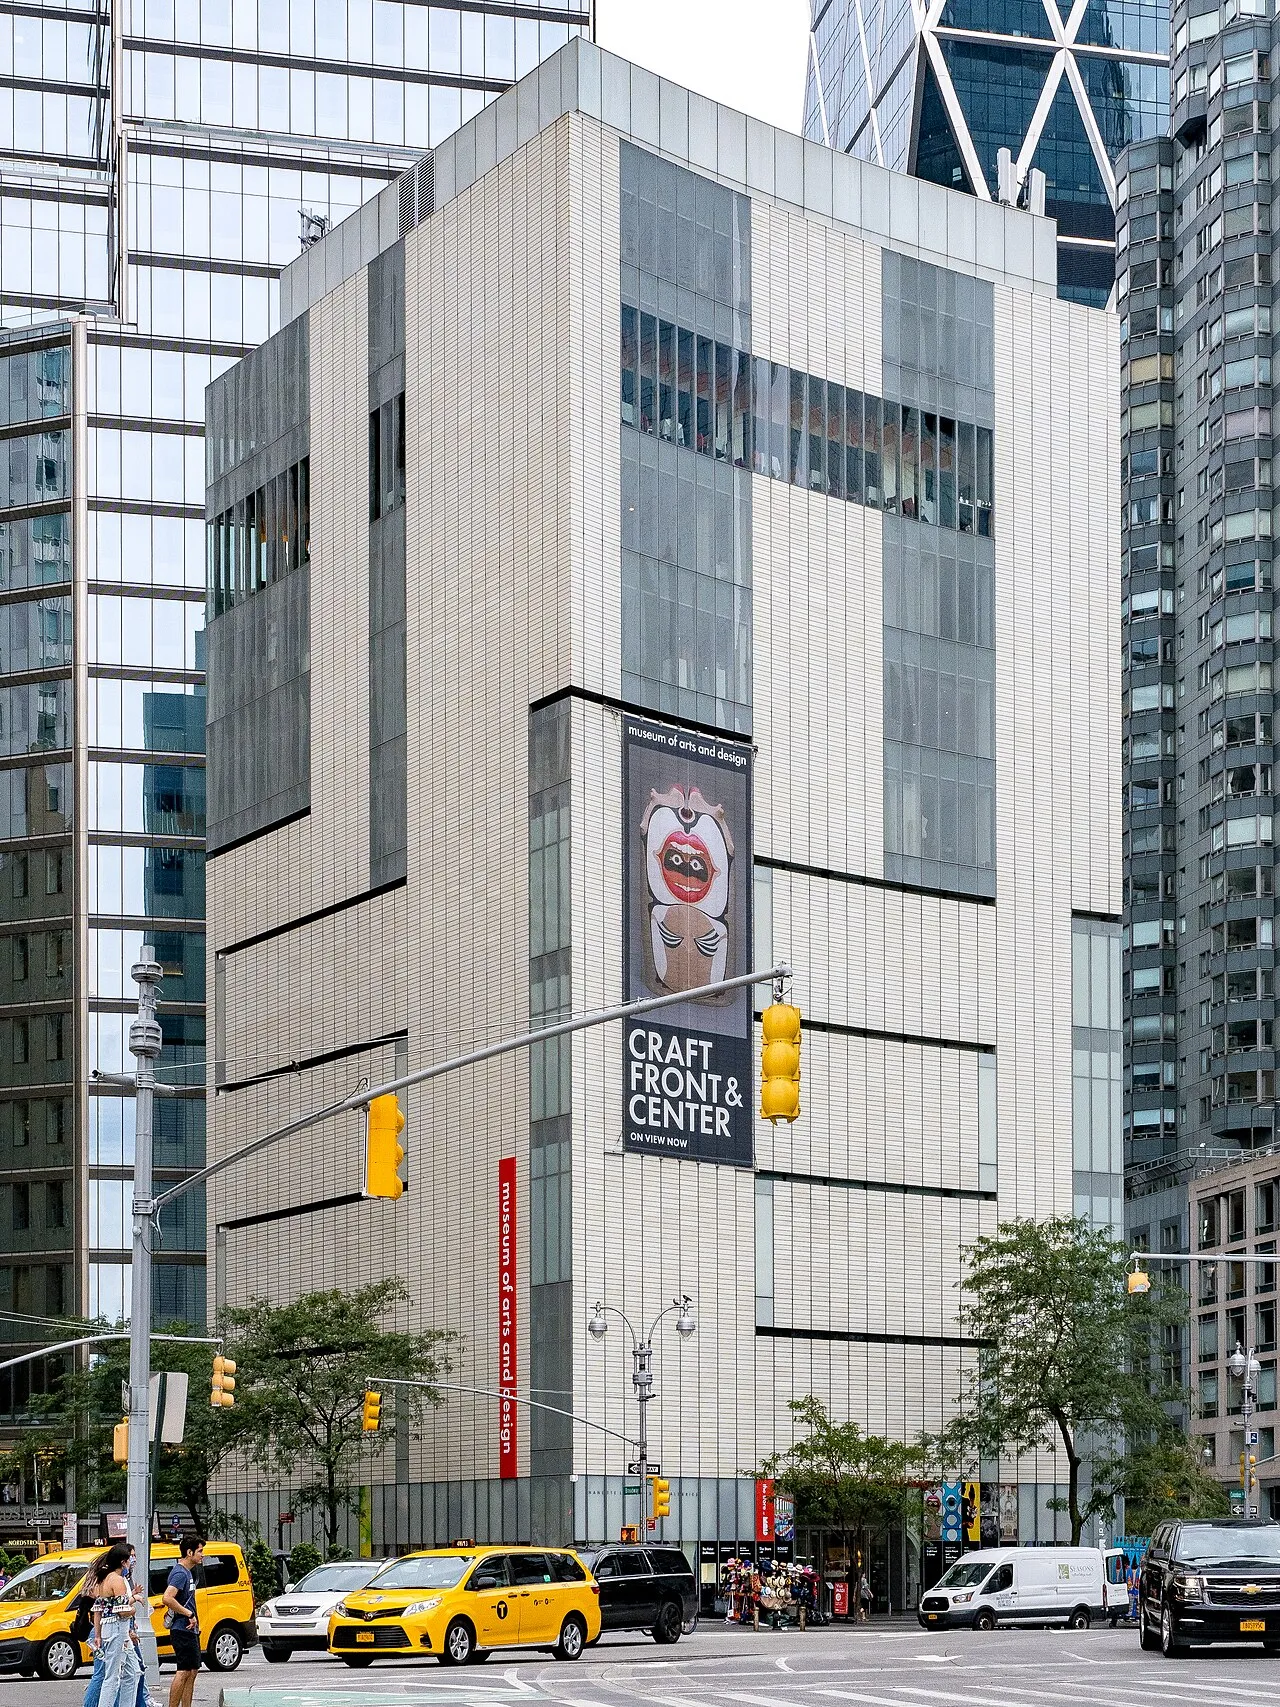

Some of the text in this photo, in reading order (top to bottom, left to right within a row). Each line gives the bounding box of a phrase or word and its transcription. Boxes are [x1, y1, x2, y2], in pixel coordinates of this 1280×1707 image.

[628, 725, 747, 767] museum of arts and design
[629, 1028, 713, 1070] CRAFT
[631, 1060, 744, 1107] FRONT &
[629, 1094, 731, 1137] CENTER
[630, 1132, 688, 1148] ON VIEW NOW
[500, 1182, 514, 1454] museum of arts and design
[1070, 1565, 1094, 1573] SEASONS
